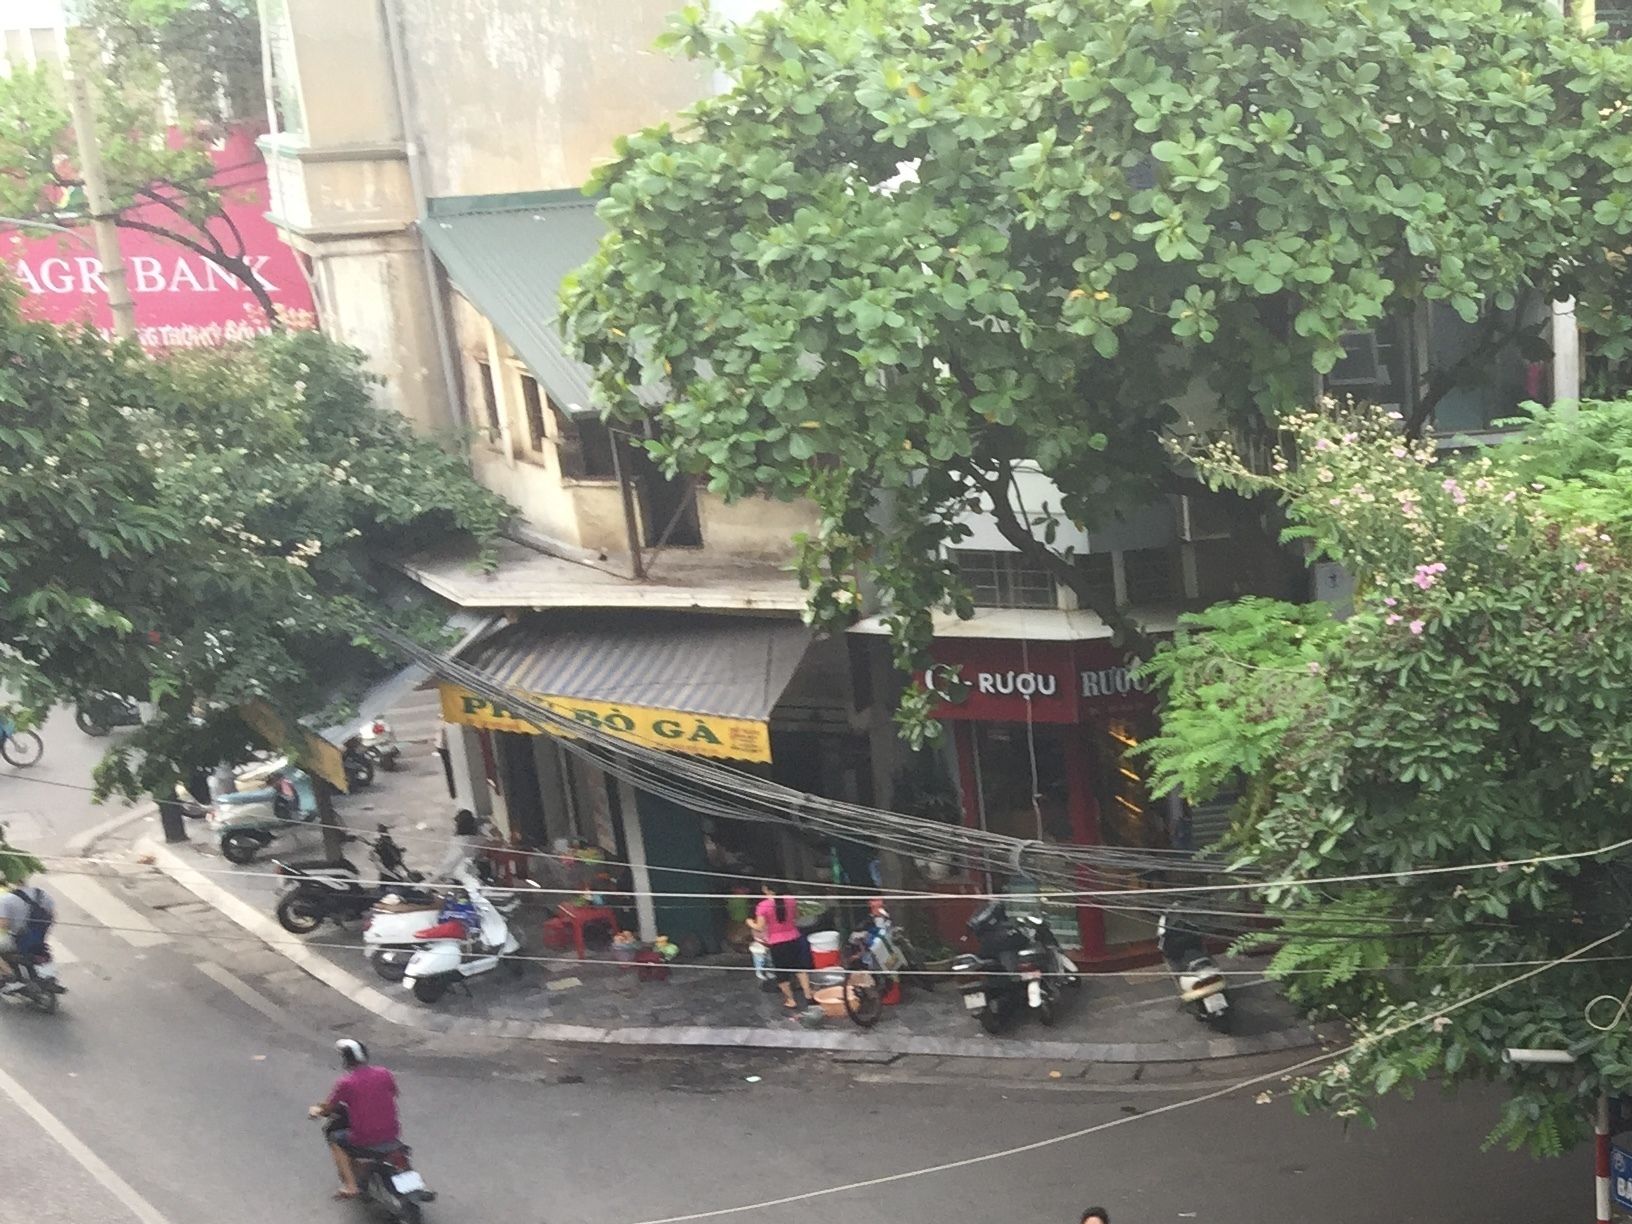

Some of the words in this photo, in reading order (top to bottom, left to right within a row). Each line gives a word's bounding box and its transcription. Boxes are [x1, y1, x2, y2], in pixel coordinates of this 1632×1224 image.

[15, 255, 280, 294] AGRBANK
[978, 670, 1057, 700] RƯỢU
[652, 719, 723, 746] GÀ
